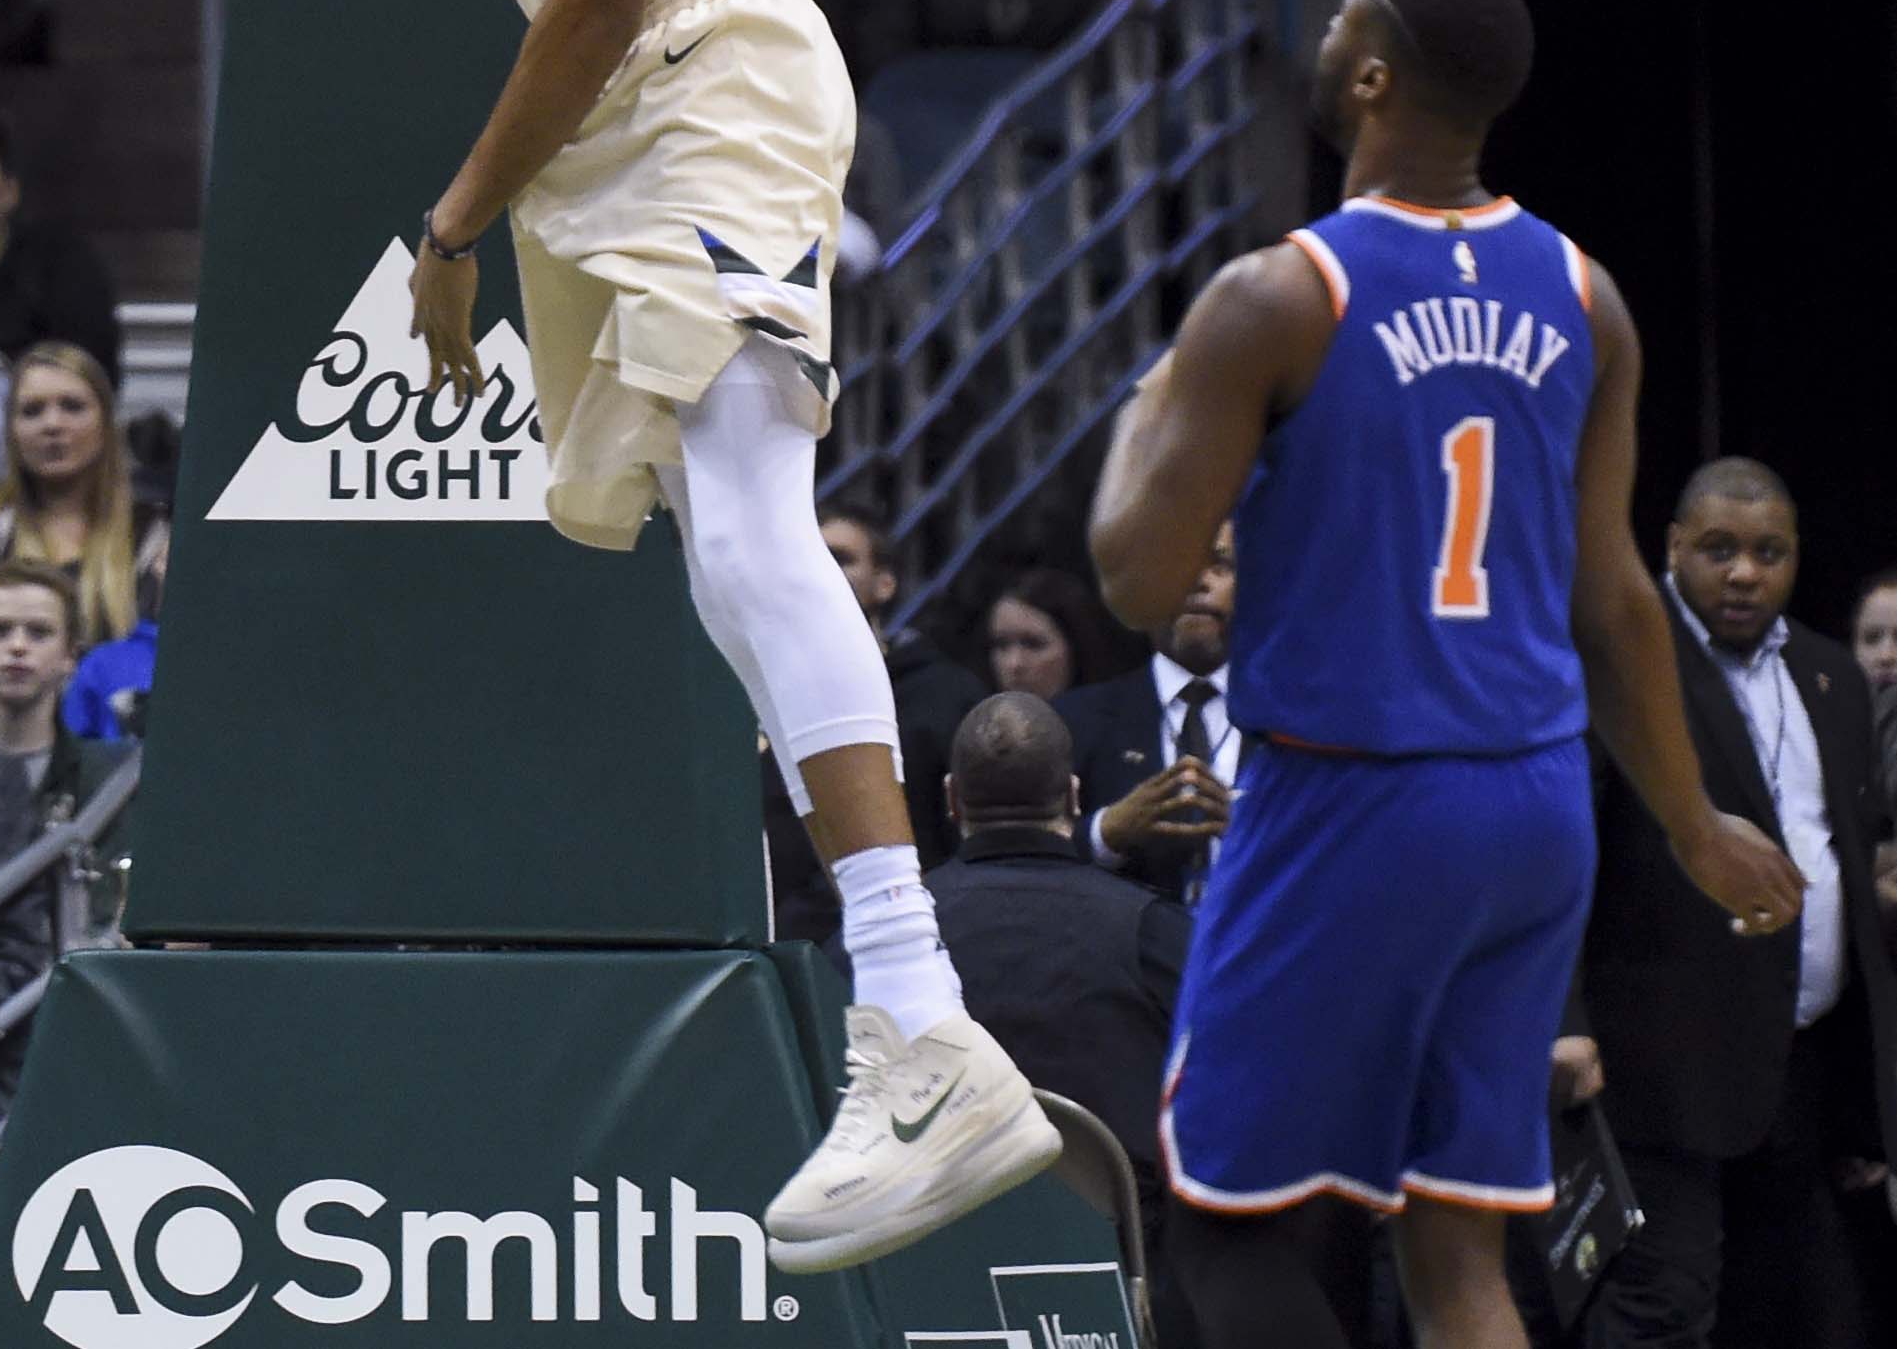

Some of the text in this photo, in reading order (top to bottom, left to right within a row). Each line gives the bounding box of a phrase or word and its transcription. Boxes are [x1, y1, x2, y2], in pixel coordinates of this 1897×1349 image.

[275, 330, 543, 443] Coor
[1375, 298, 1570, 388] MUDIAY
[329, 449, 522, 500] LIGHT
[1433, 415, 1495, 618] 1
